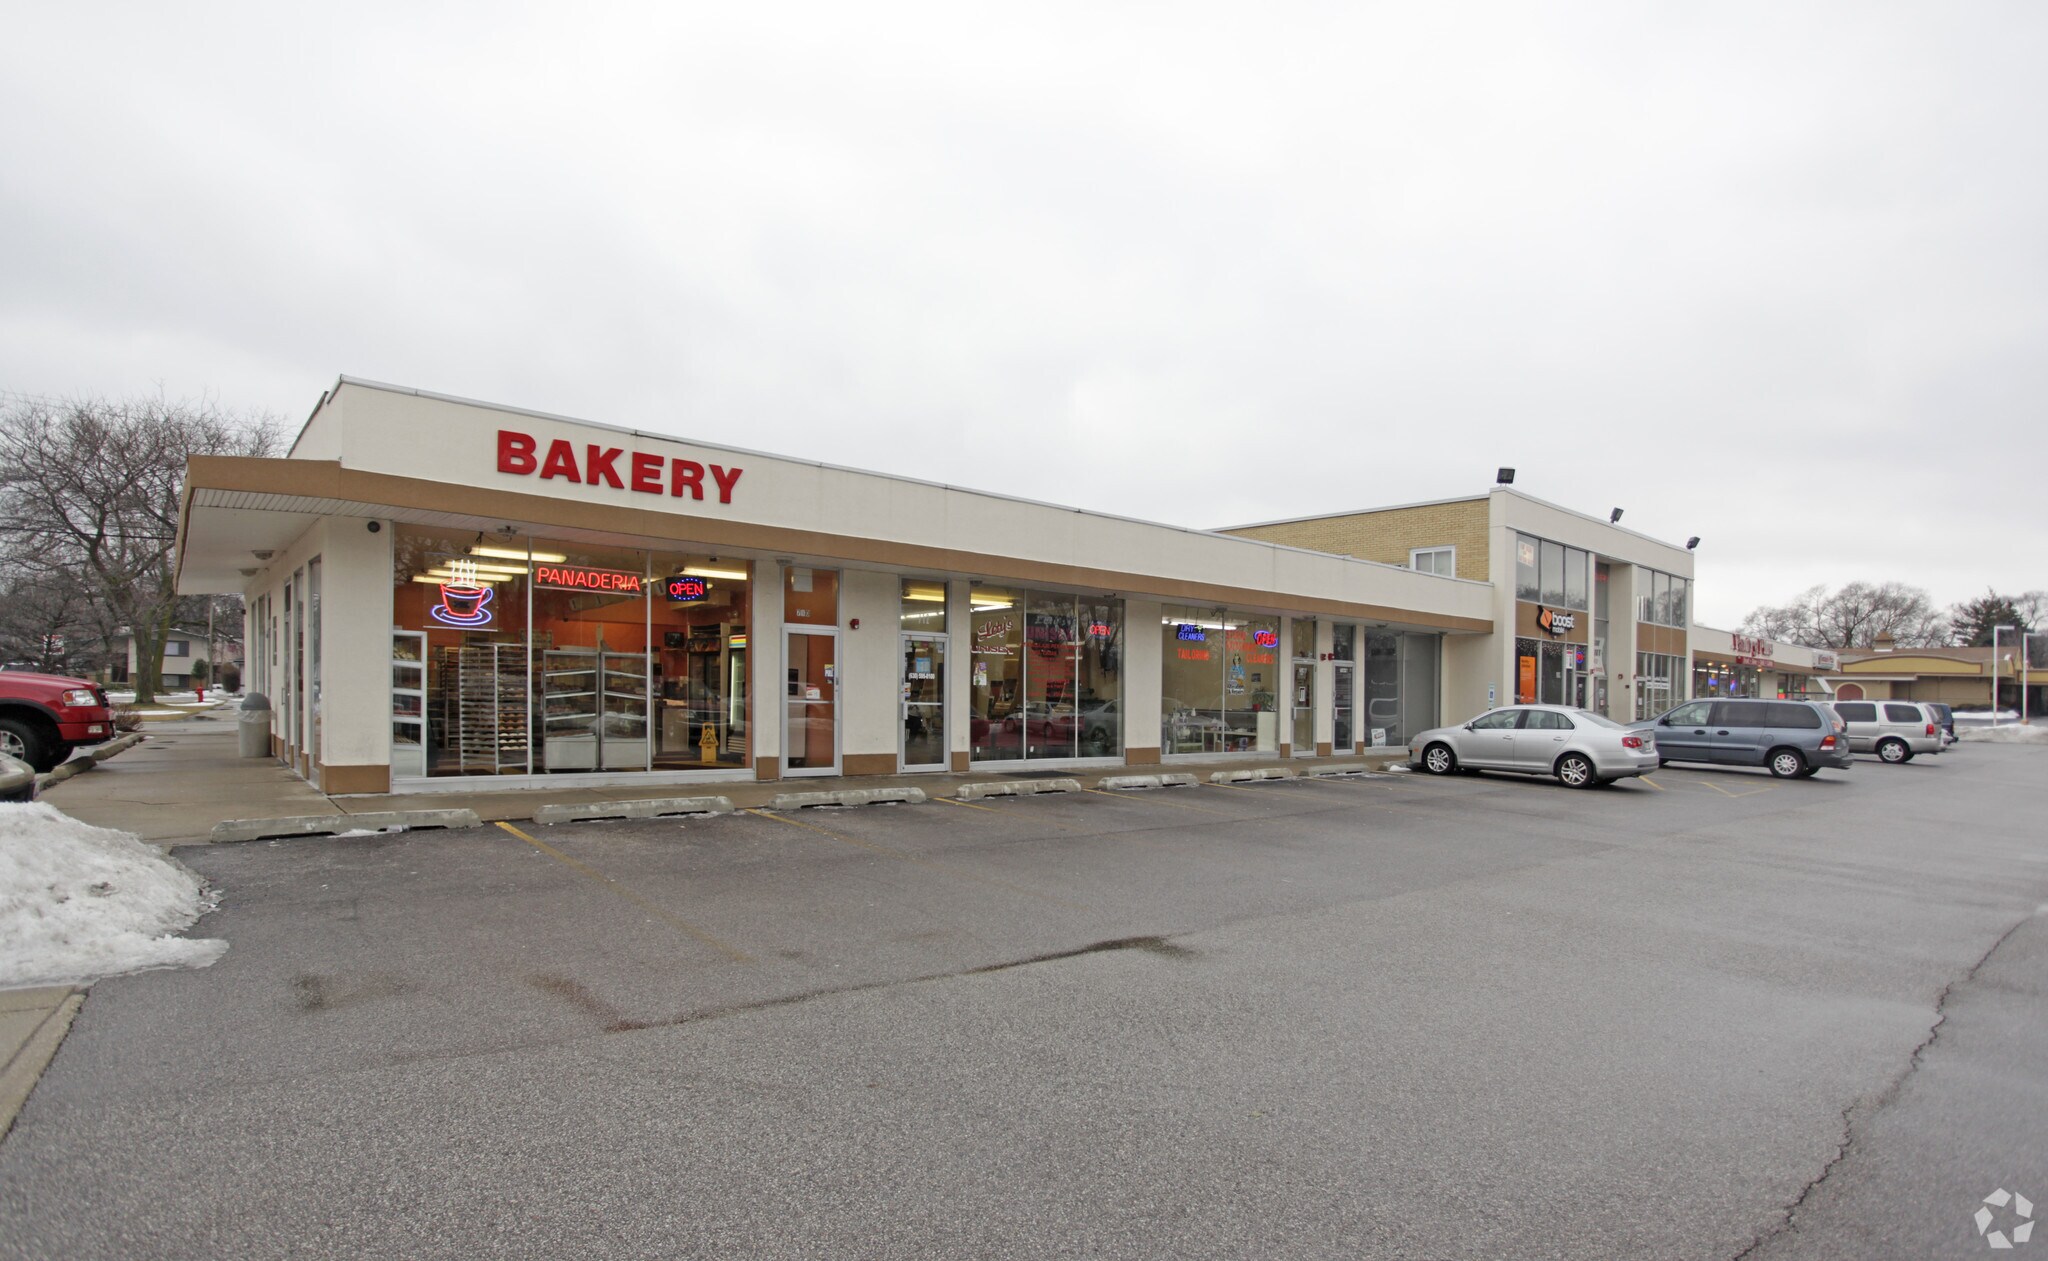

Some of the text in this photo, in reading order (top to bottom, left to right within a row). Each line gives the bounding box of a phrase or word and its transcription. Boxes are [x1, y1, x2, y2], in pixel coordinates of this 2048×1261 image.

[497, 430, 743, 504] BAKERY
[537, 567, 641, 592] PANADERIA
[669, 583, 703, 595] OPEN
[1552, 611, 1575, 629] boost
[1090, 624, 1111, 636] OPEN
[1178, 632, 1206, 641] CLEANERS
[1257, 633, 1277, 646] OPEN
